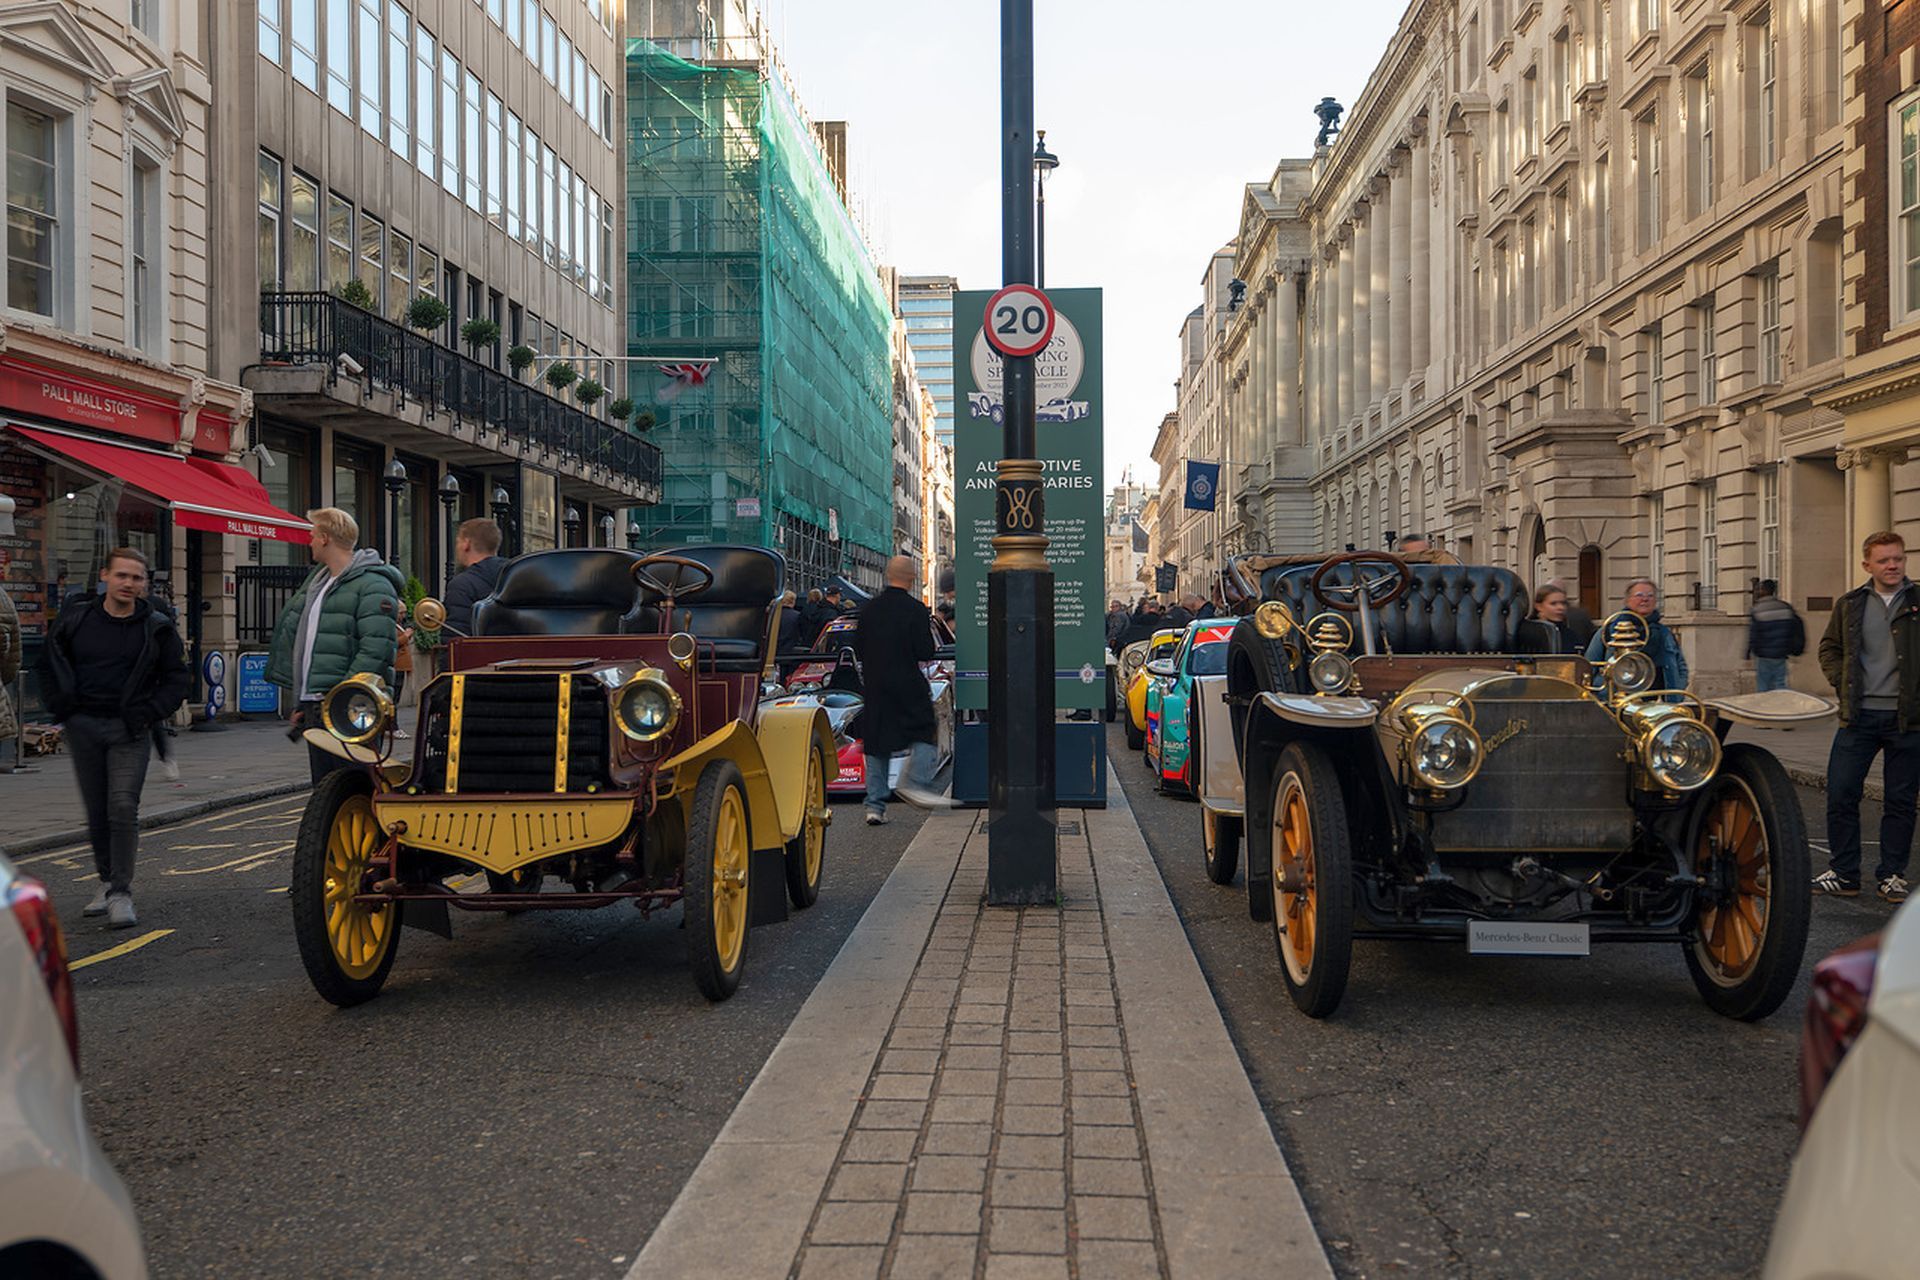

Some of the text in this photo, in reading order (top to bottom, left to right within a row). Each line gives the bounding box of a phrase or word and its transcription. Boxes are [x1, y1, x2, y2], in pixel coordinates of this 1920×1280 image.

[997, 305, 1045, 334] 20
[41, 383, 137, 418] PALL MALL STORE
[205, 428, 216, 440] 40
[976, 460, 1081, 472] AUOTIVE
[965, 477, 1093, 489] ANNSARIES
[227, 521, 277, 538] PALL MALL STORE
[1475, 931, 1583, 943] Mercedes-Benz Classic
